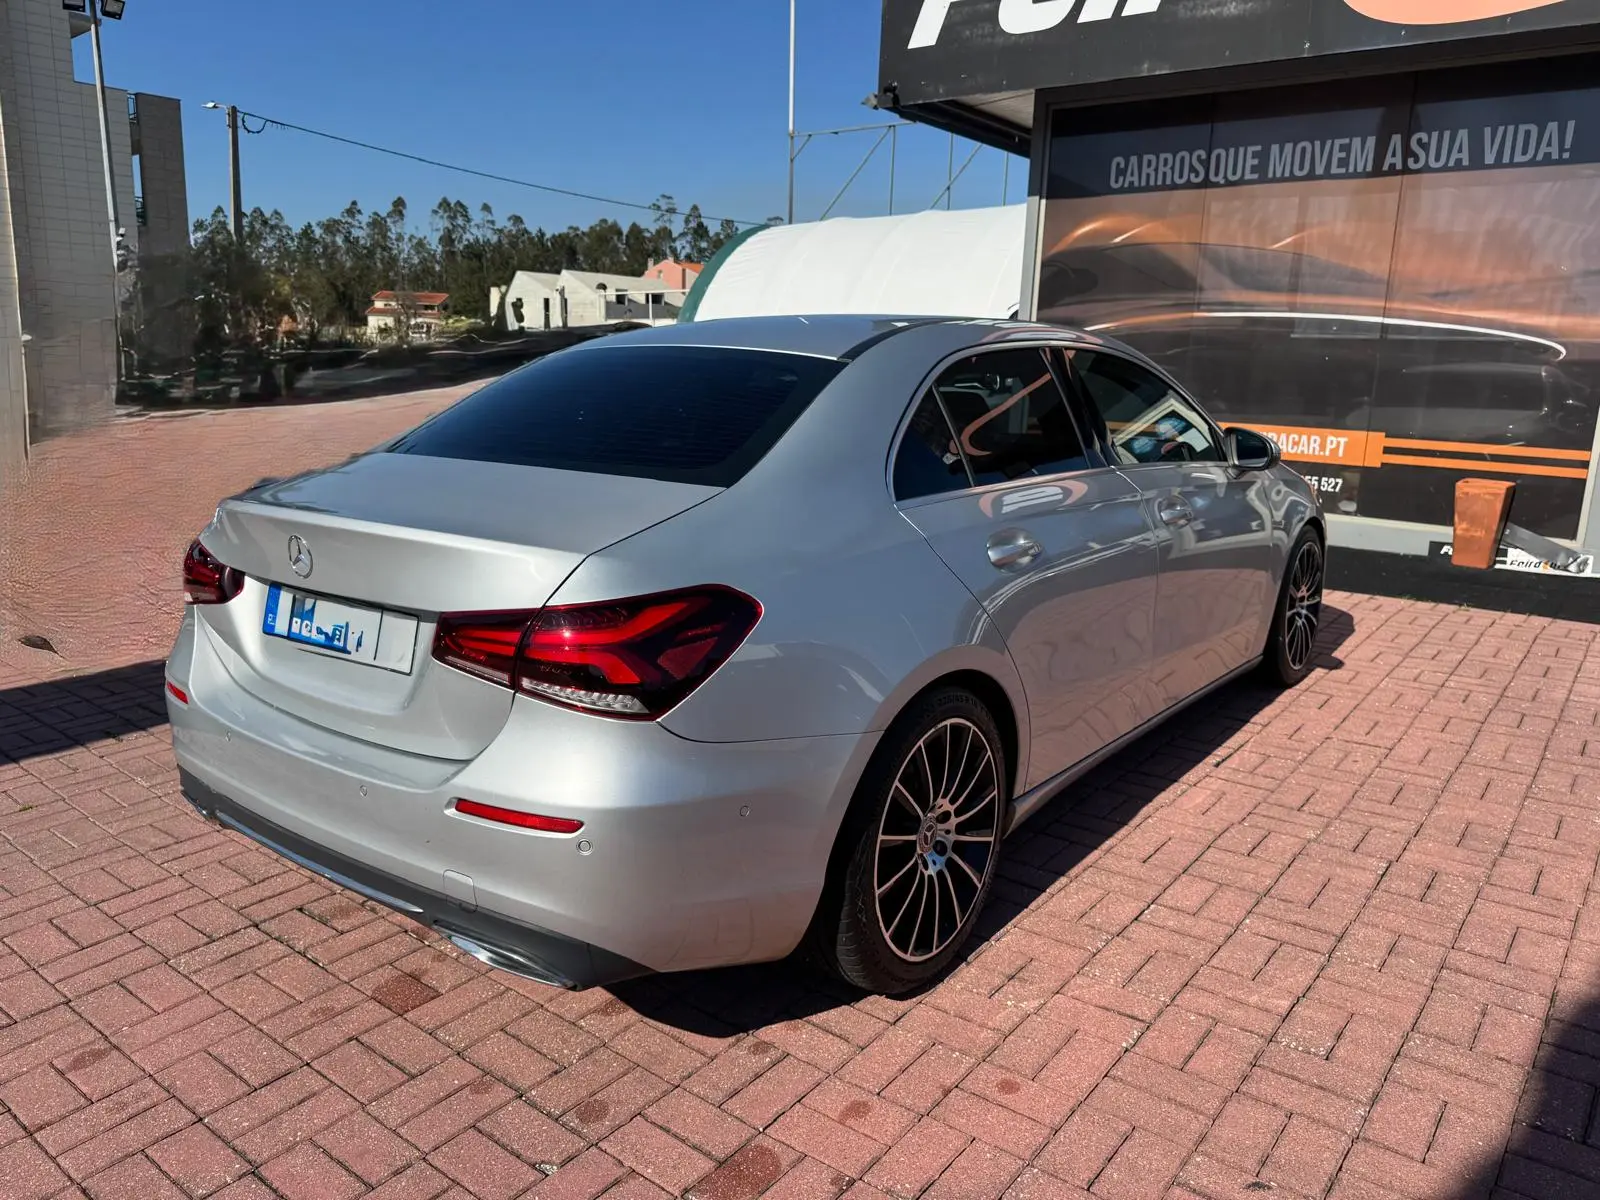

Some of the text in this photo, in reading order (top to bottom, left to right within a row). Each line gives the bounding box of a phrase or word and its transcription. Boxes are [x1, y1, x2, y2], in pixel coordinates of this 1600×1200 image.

[1110, 120, 1576, 189] CARROS QUE MOVEM A SUA VIDA!
[1320, 477, 1343, 492] 527
